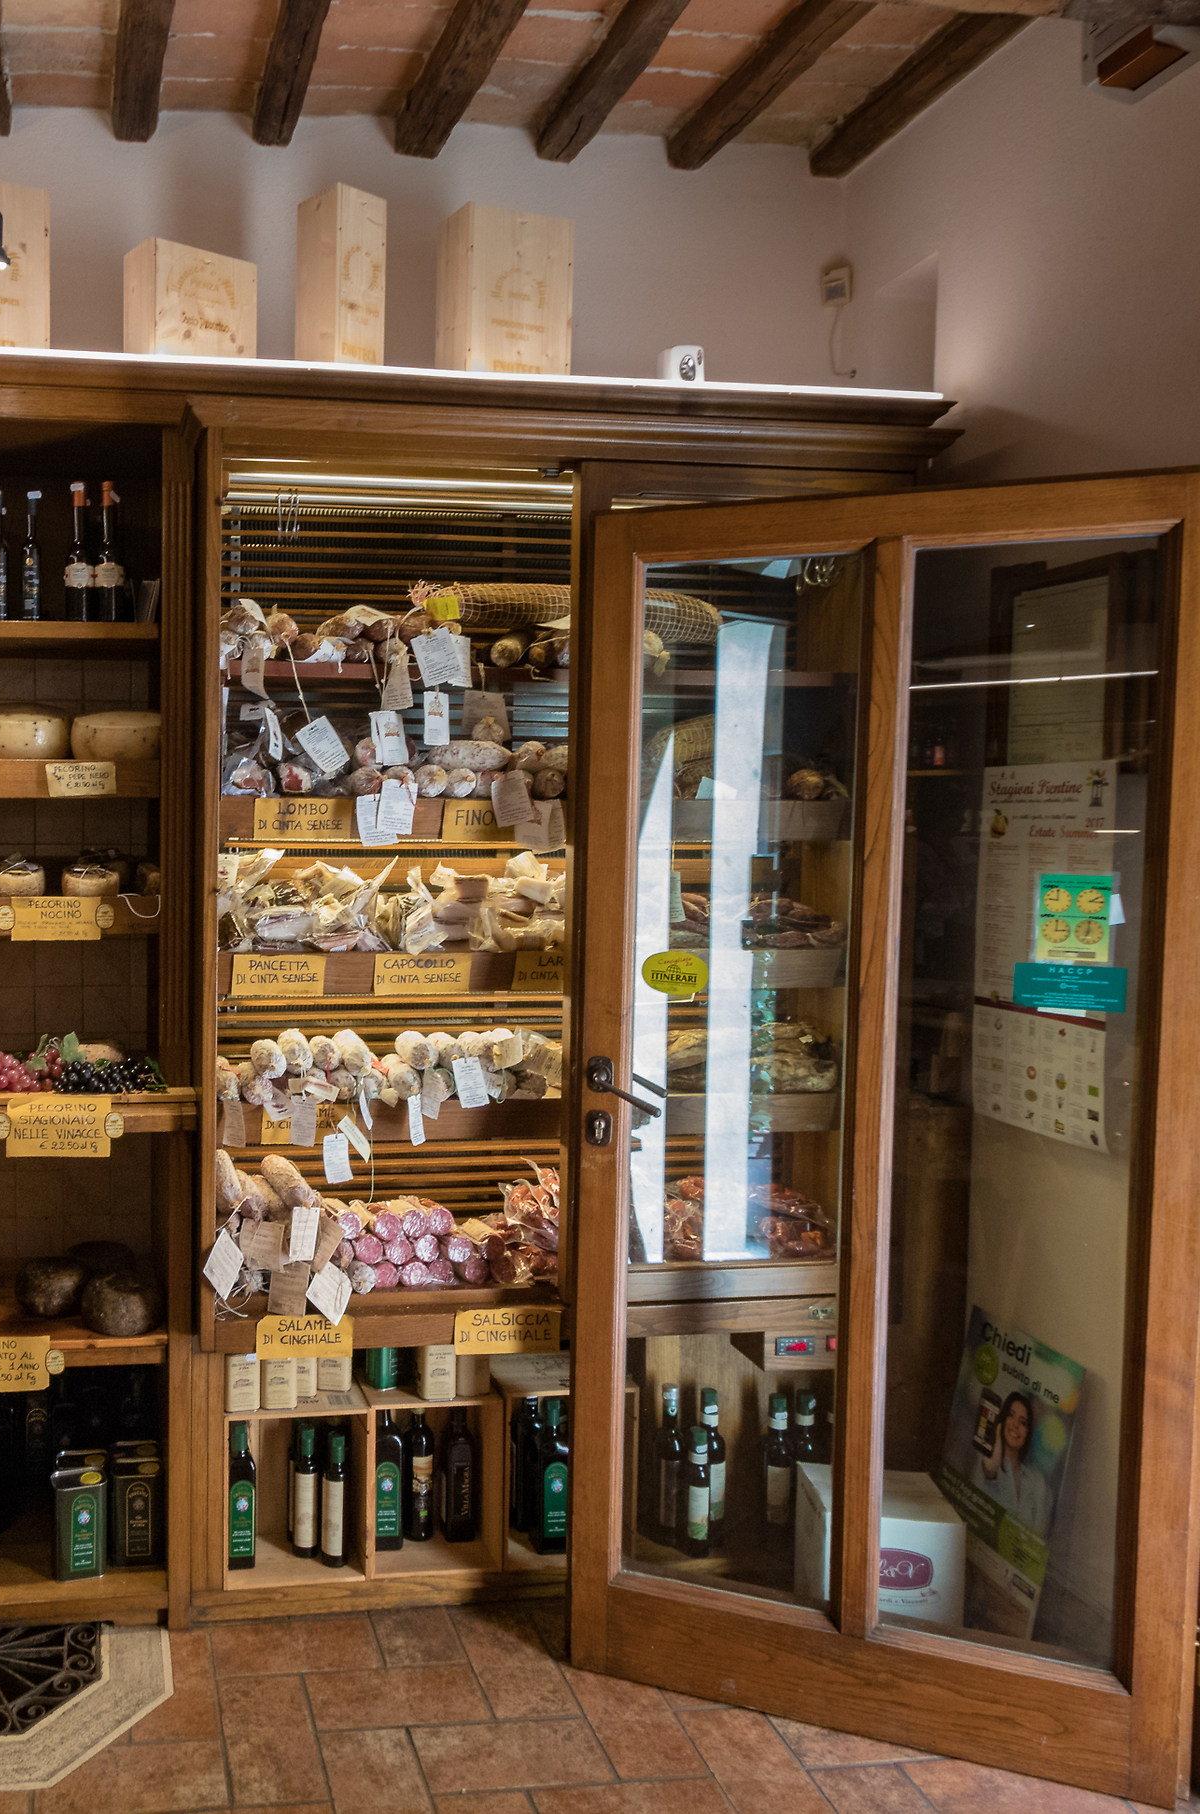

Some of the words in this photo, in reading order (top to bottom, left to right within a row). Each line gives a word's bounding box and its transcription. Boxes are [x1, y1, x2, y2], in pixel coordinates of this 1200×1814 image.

[54, 764, 96, 773] PECORINO
[89, 772, 110, 780] NERO
[988, 781, 1034, 799] Stagioni
[277, 802, 329, 816] LOMBO
[257, 819, 268, 830] DI
[271, 819, 303, 831] CINTA
[306, 819, 343, 831] SENESE
[1085, 817, 1105, 828] 2017
[1029, 825, 1056, 839] Estate
[28, 900, 81, 909] PECORINO
[40, 910, 82, 919] NOCINO
[249, 958, 310, 972] PANCETTA
[383, 957, 456, 970] CAPOCOLLO
[537, 955, 564, 968] LAR
[518, 970, 529, 981] DI
[530, 969, 560, 981] CINTA
[1048, 967, 1094, 975] HACCP
[236, 973, 248, 985] DI
[249, 972, 279, 985] CINTA
[281, 971, 319, 984] SENESE
[376, 974, 388, 986] DI
[390, 973, 420, 985] CINTA
[424, 971, 462, 984] SENESE
[651, 972, 697, 983] ITINERARI
[29, 1103, 97, 1113] PECORINO
[18, 1115, 96, 1126] STAGIONATO
[13, 1128, 49, 1139] NELLE
[55, 1129, 103, 1139] VINACCE
[40, 1141, 48, 1150] €
[278, 1318, 332, 1332] SALAME
[471, 1313, 550, 1327] SALSICCIA
[263, 1334, 274, 1345] DI
[280, 1333, 342, 1345] CINGHIALE
[459, 1331, 471, 1343] DI
[476, 1328, 552, 1343] CINGHIALE
[981, 1322, 1033, 1366] Chiedi
[20, 1351, 35, 1360] AL
[9, 1362, 15, 1370] 1
[17, 1362, 40, 1371] ANNO
[1001, 1363, 1031, 1386] subito
[1031, 1381, 1042, 1393] di
[1043, 1388, 1060, 1404] me
